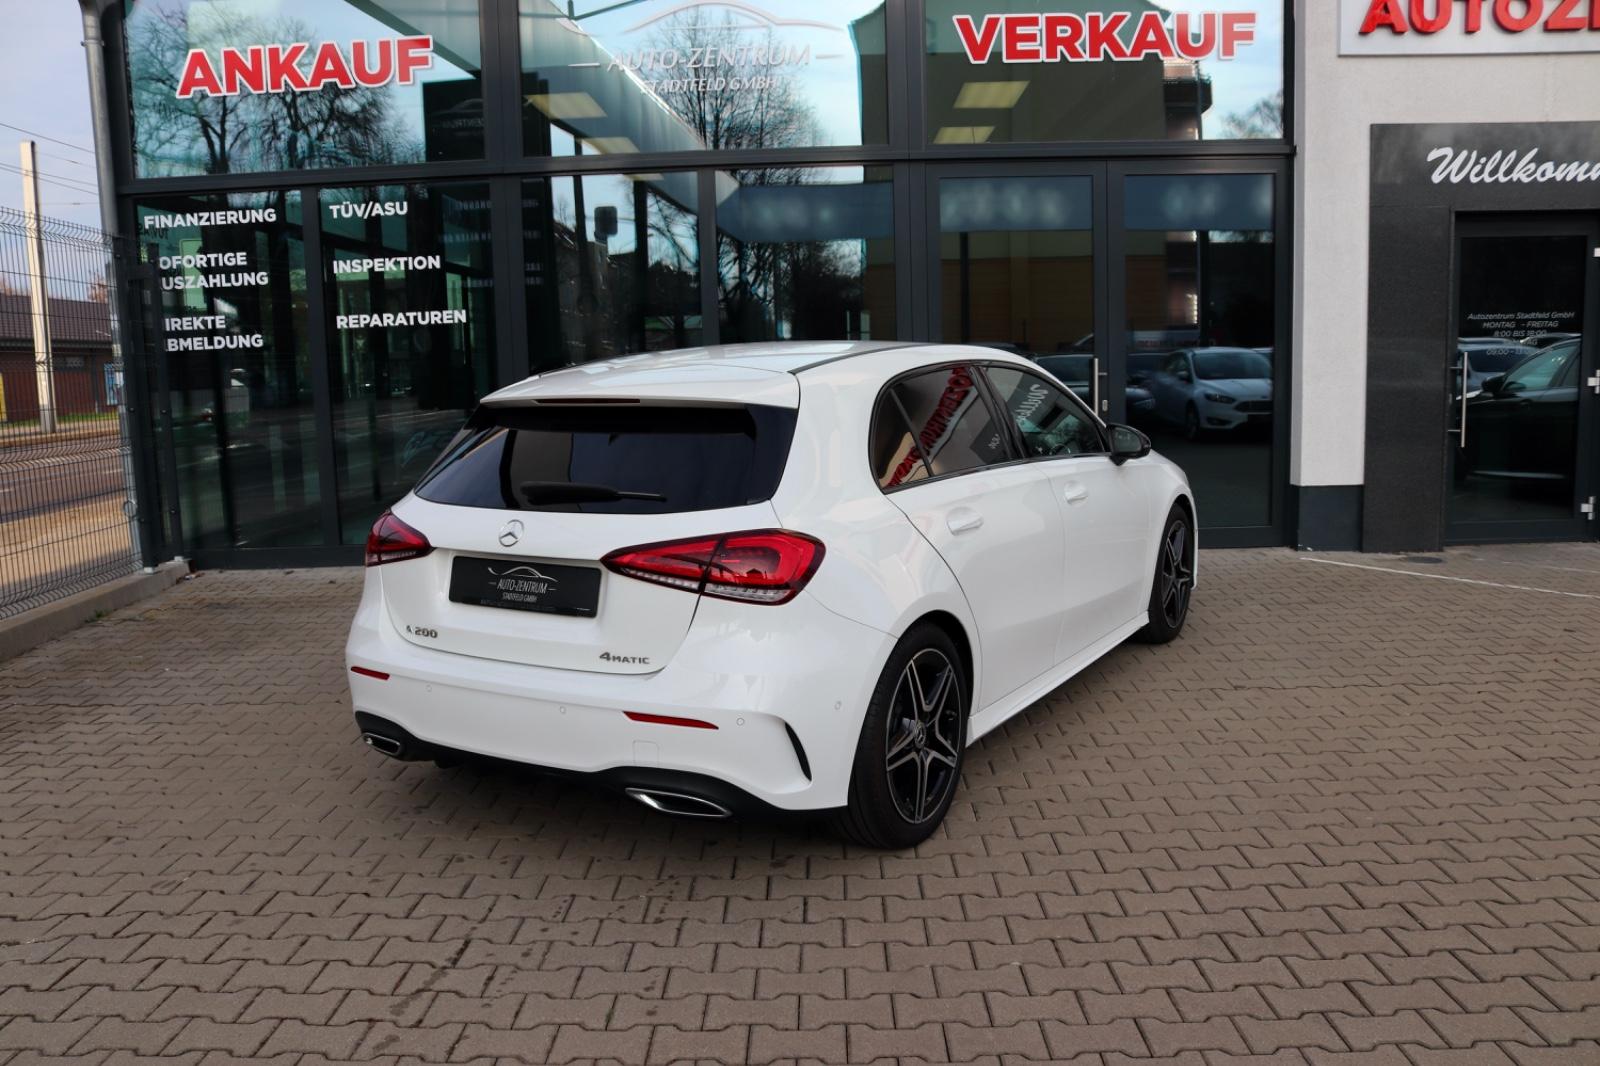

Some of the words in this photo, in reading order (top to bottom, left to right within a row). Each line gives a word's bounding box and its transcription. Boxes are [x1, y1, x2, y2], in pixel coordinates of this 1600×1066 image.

[1358, 0, 1600, 35] AUTOZ
[953, 11, 1256, 64] VERKAUF
[607, 44, 811, 72] AUTO-ZENTRUM
[176, 36, 433, 99] ANKAUF
[144, 208, 277, 230] FINANZIERUNG
[330, 201, 409, 219] TÜV/ASU
[159, 252, 248, 270] OFORTIGE
[333, 255, 441, 274] INSPEKTION
[161, 271, 269, 290] USZAHLUNG
[165, 315, 226, 331] IREKTE
[336, 309, 467, 329] REPARATUREN
[1526, 320, 1559, 328] FREITAG
[166, 334, 264, 352] BMELDUNG
[496, 578, 547, 594] AUTO-ZENTRUM
[415, 626, 439, 639] 200
[599, 652, 650, 665] 4MATIC
